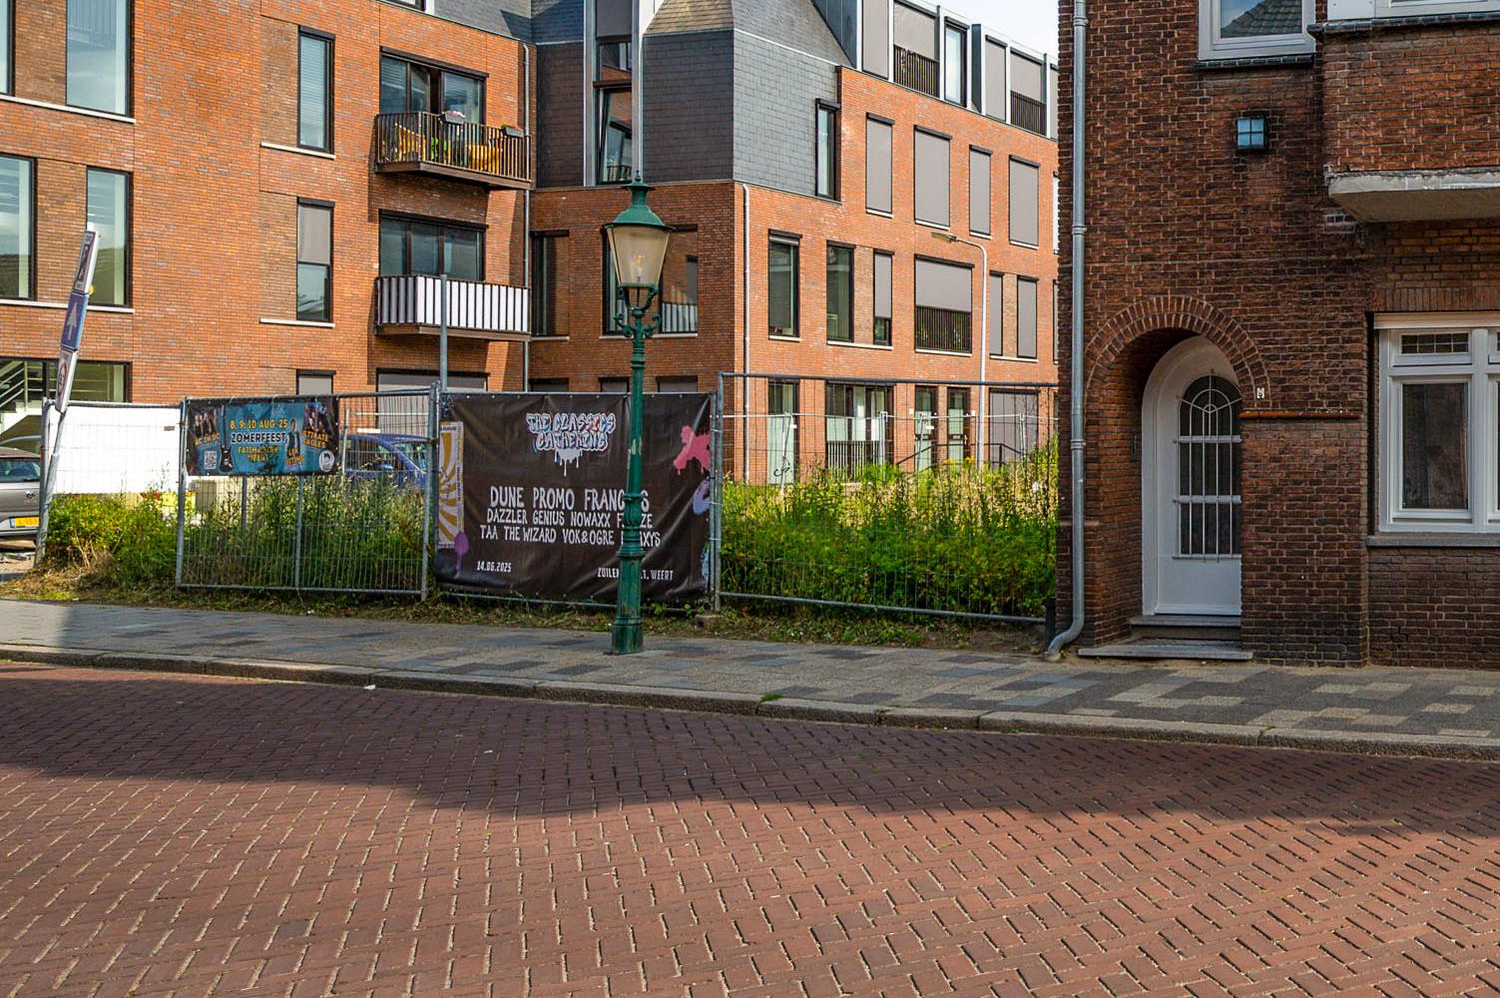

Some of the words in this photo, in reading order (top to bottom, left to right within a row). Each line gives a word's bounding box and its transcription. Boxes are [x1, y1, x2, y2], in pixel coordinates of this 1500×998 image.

[259, 418, 275, 429] AUG
[230, 432, 287, 444] ZOMERFEEST
[491, 486, 525, 508] DUNE
[533, 486, 575, 510] PROMO
[487, 508, 528, 524] DAZZLER
[533, 510, 565, 526] GENIUS
[571, 511, 611, 528] NOWAXX
[480, 525, 498, 541] TAA
[503, 525, 521, 542] THE
[523, 527, 557, 544] WIZARD
[476, 560, 512, 574] 14.06.2025
[650, 570, 674, 581] WEERT
